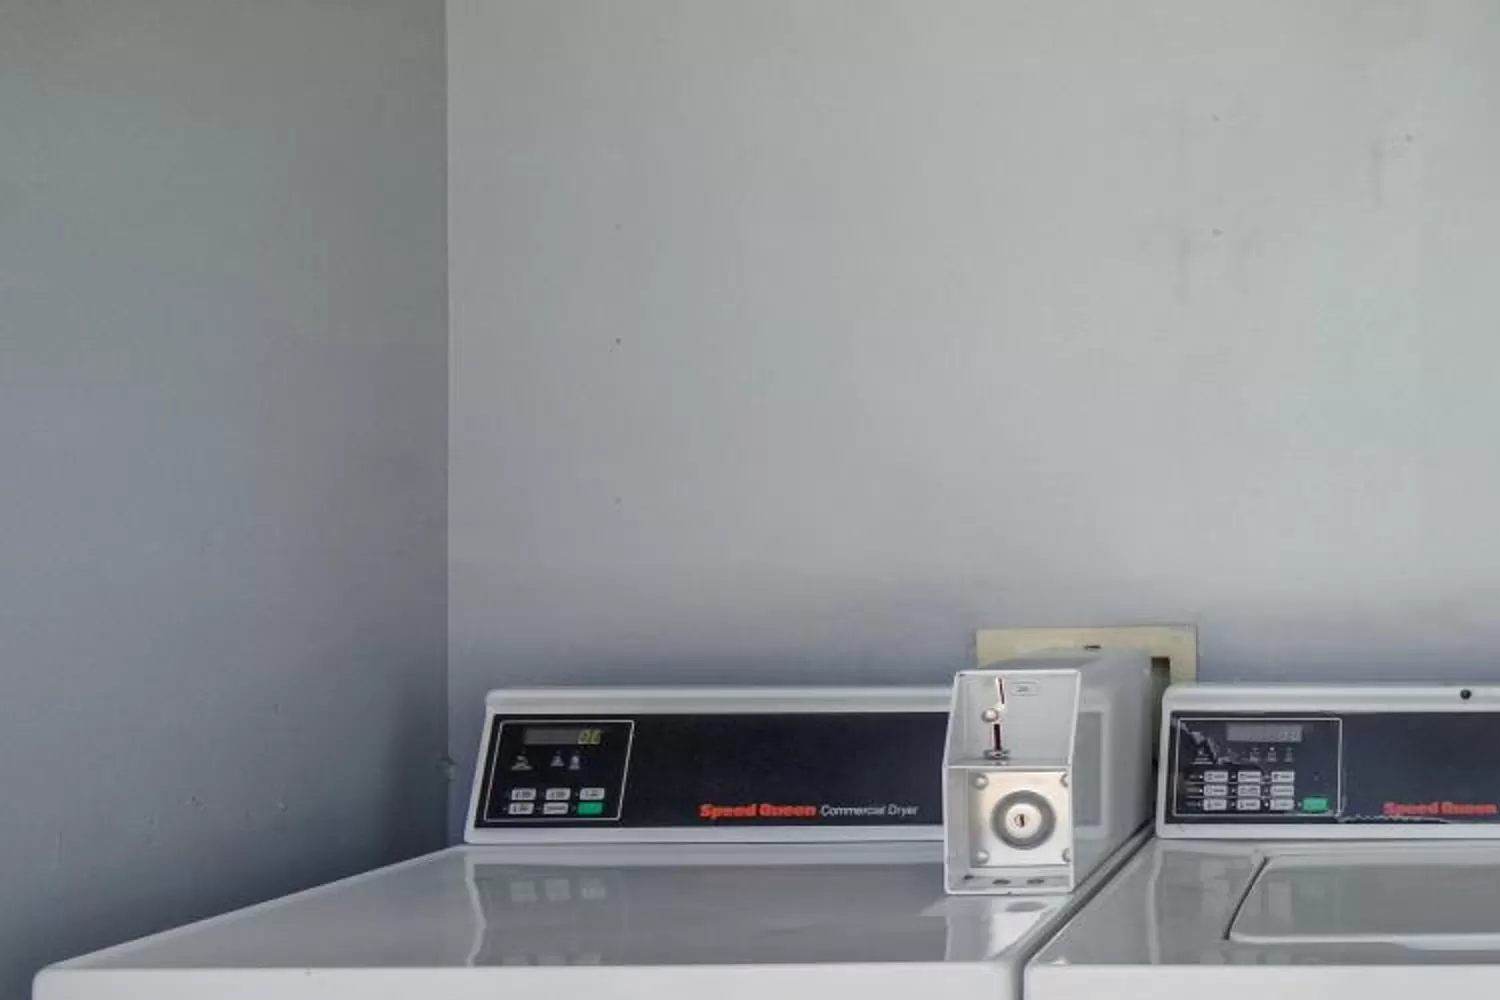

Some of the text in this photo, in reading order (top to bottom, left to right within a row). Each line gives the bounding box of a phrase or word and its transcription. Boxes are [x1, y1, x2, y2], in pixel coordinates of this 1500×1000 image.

[699, 803, 817, 819] Speed Queen
[819, 804, 919, 817] Commercial Dryer
[1383, 802, 1438, 817] Speed
